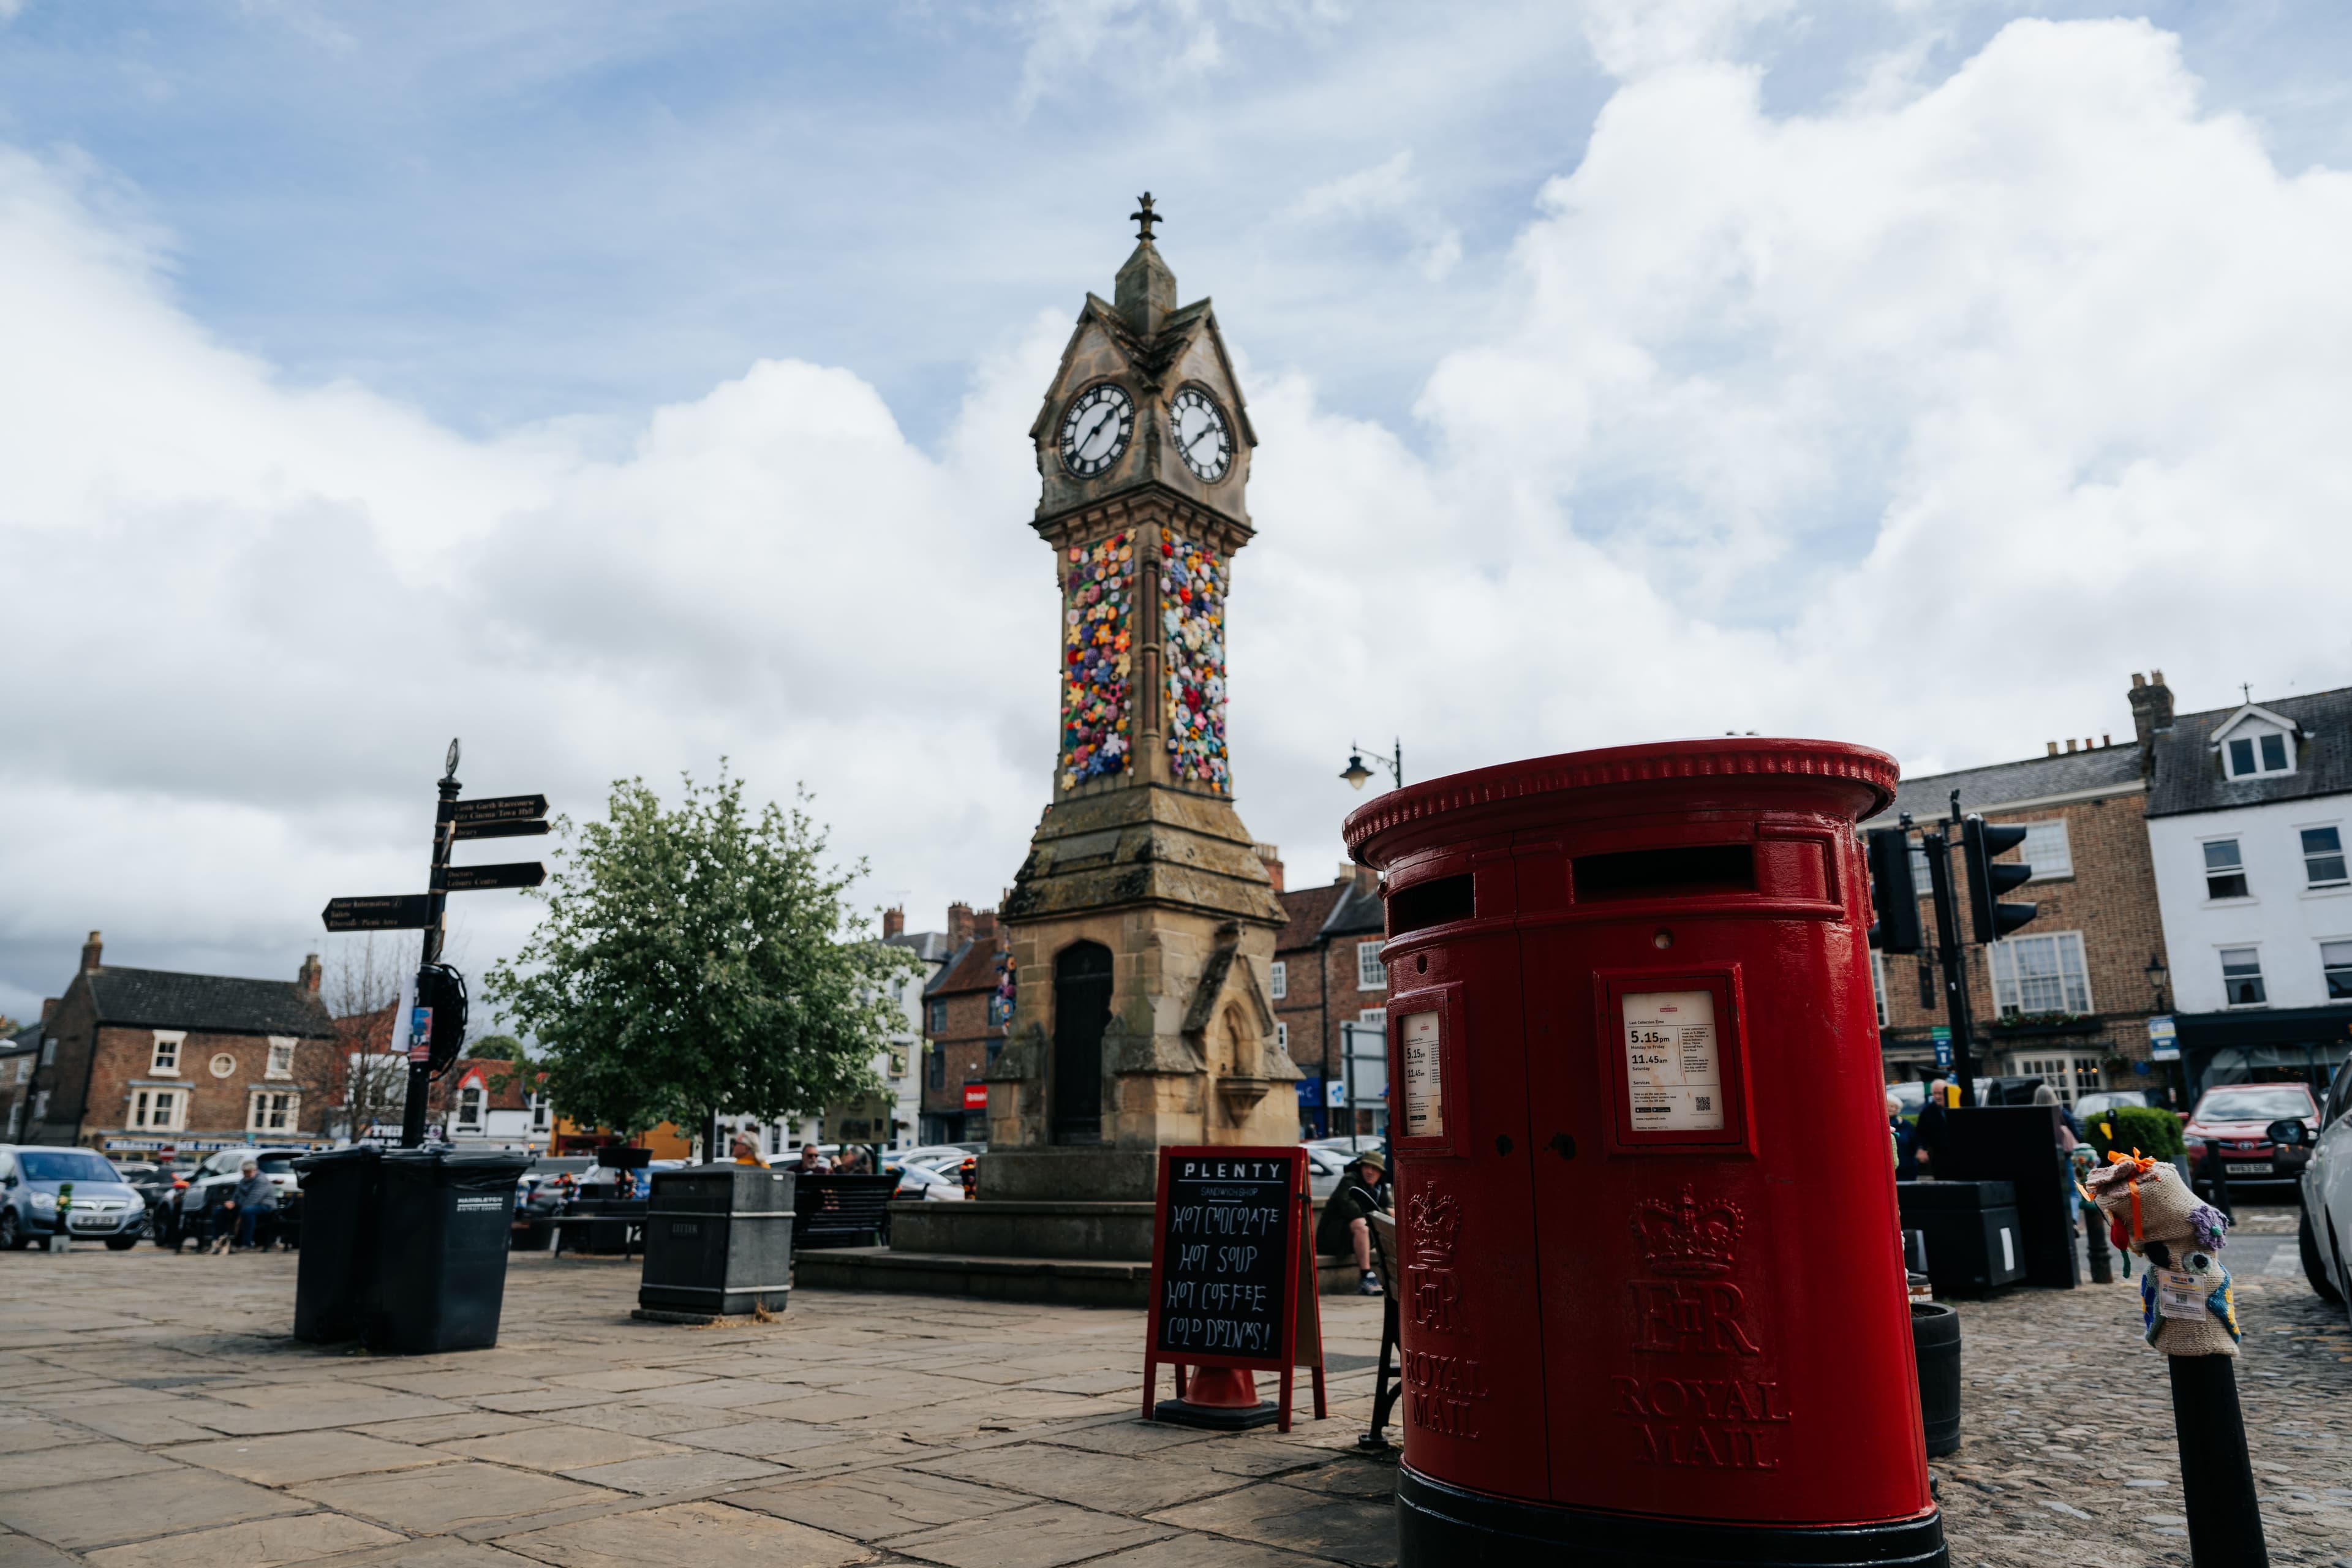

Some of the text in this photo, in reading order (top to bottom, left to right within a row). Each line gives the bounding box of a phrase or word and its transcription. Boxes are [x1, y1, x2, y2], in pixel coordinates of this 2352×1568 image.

[498, 799, 535, 808] Racecourse
[1631, 1030, 1670, 1043] 5.15pm
[1407, 1048, 1425, 1060] 5.15pm
[1632, 1055, 1668, 1064] 11.45am
[1408, 1069, 1425, 1078] 11.45am
[1185, 1163, 1280, 1178] PLENTY
[1200, 1186, 1258, 1196] SANDWICH SHOP
[673, 1224, 698, 1234] LITTER
[1172, 1205, 1280, 1236] HOT CHOCOLATE
[1178, 1243, 1257, 1273] HOT SOUP
[1167, 1280, 1267, 1312] HOT COFFEE
[1167, 1317, 1271, 1351] COLD DRINKS!
[1405, 1348, 1489, 1399] ROYAL
[1610, 1374, 1792, 1422] ROYAL
[1411, 1389, 1480, 1439] MAIL
[1632, 1423, 1779, 1469] MAIL
